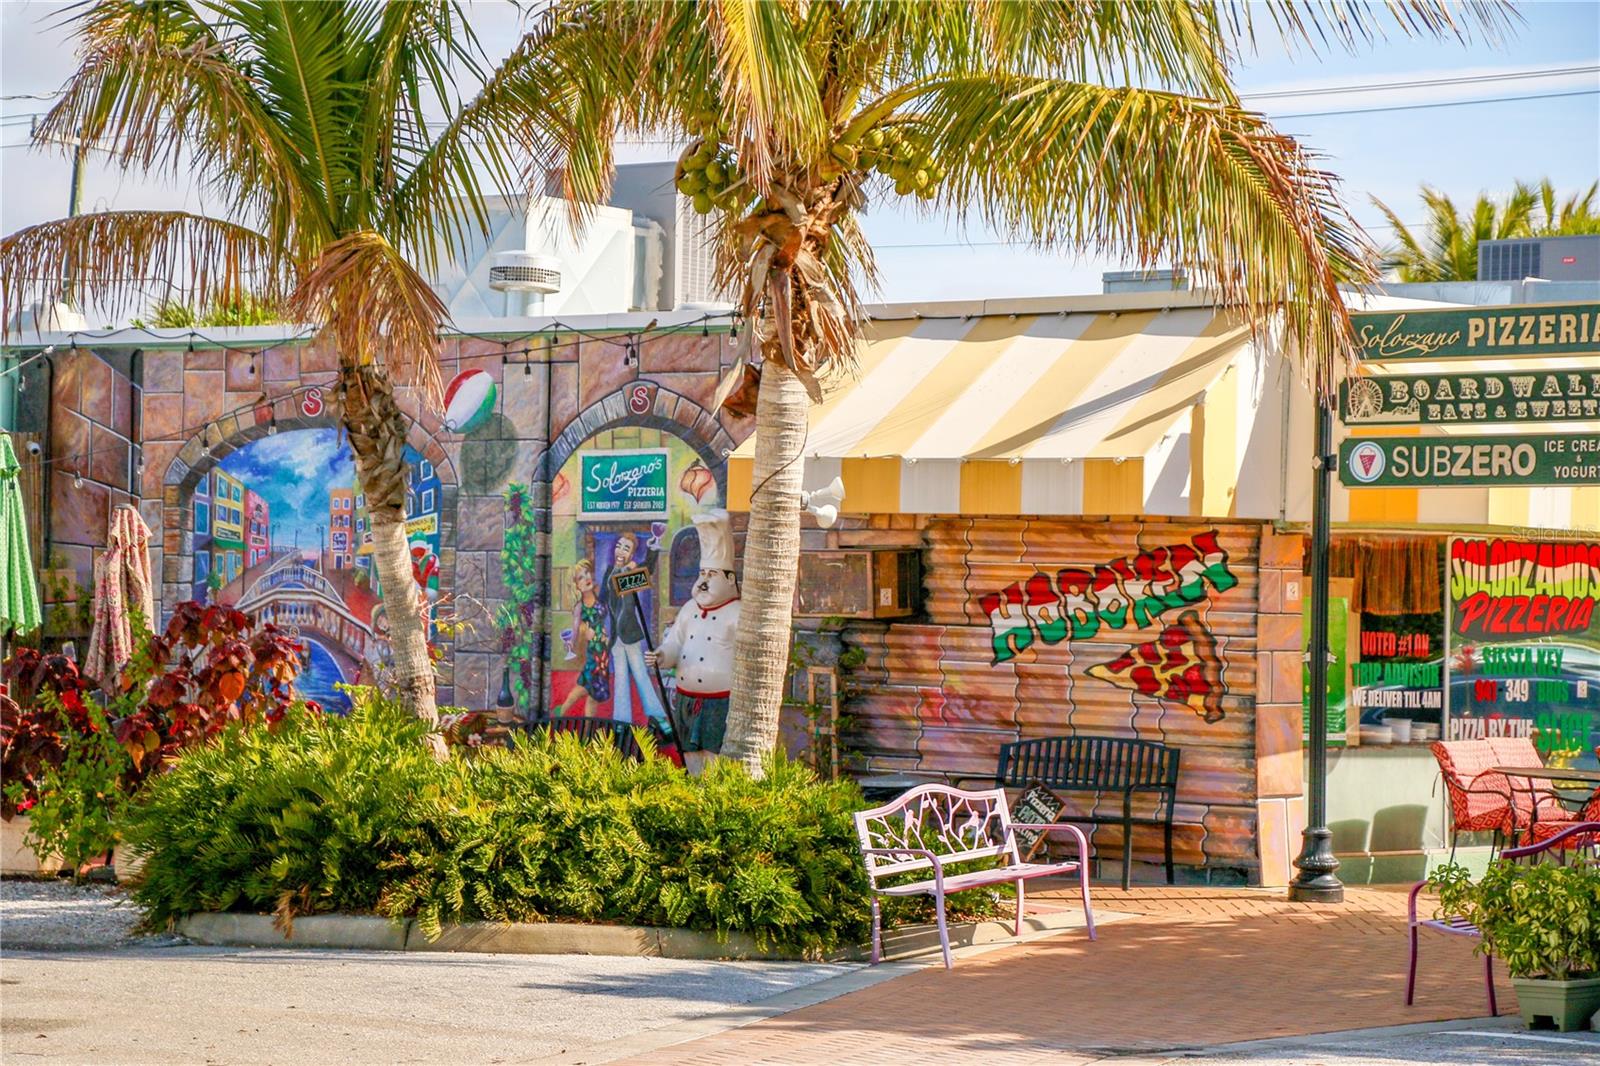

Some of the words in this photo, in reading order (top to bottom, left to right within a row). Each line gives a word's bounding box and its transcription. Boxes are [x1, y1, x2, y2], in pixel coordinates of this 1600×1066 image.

[1354, 314, 1460, 356] Solorzano
[302, 387, 323, 417] S
[630, 385, 650, 414] S
[1427, 402, 1487, 420] EATS
[1495, 405, 1506, 418] &
[1515, 399, 1600, 418] SWEET
[1391, 443, 1537, 477] SUBZERO
[1544, 440, 1565, 452] ICE
[586, 457, 662, 494] Solorzano's
[627, 486, 665, 497] PIZZERIA
[1459, 590, 1595, 633] PIZZERIA
[1361, 631, 1396, 657] VOTED
[1398, 634, 1413, 657] #1
[1414, 633, 1430, 657] ON
[1352, 662, 1381, 687] TRIP
[1384, 662, 1440, 688] ADVISOR
[1537, 647, 1564, 675] KEY
[1352, 688, 1367, 707] WE
[1368, 690, 1402, 708] DELIVER
[1404, 690, 1421, 708] TILL
[1421, 691, 1442, 708] 4AM
[1505, 679, 1529, 702] 349
[1450, 716, 1486, 741] PIZZA
[1488, 718, 1506, 738] BY
[1508, 718, 1533, 738] THE
[1536, 712, 1593, 753] SLICE
